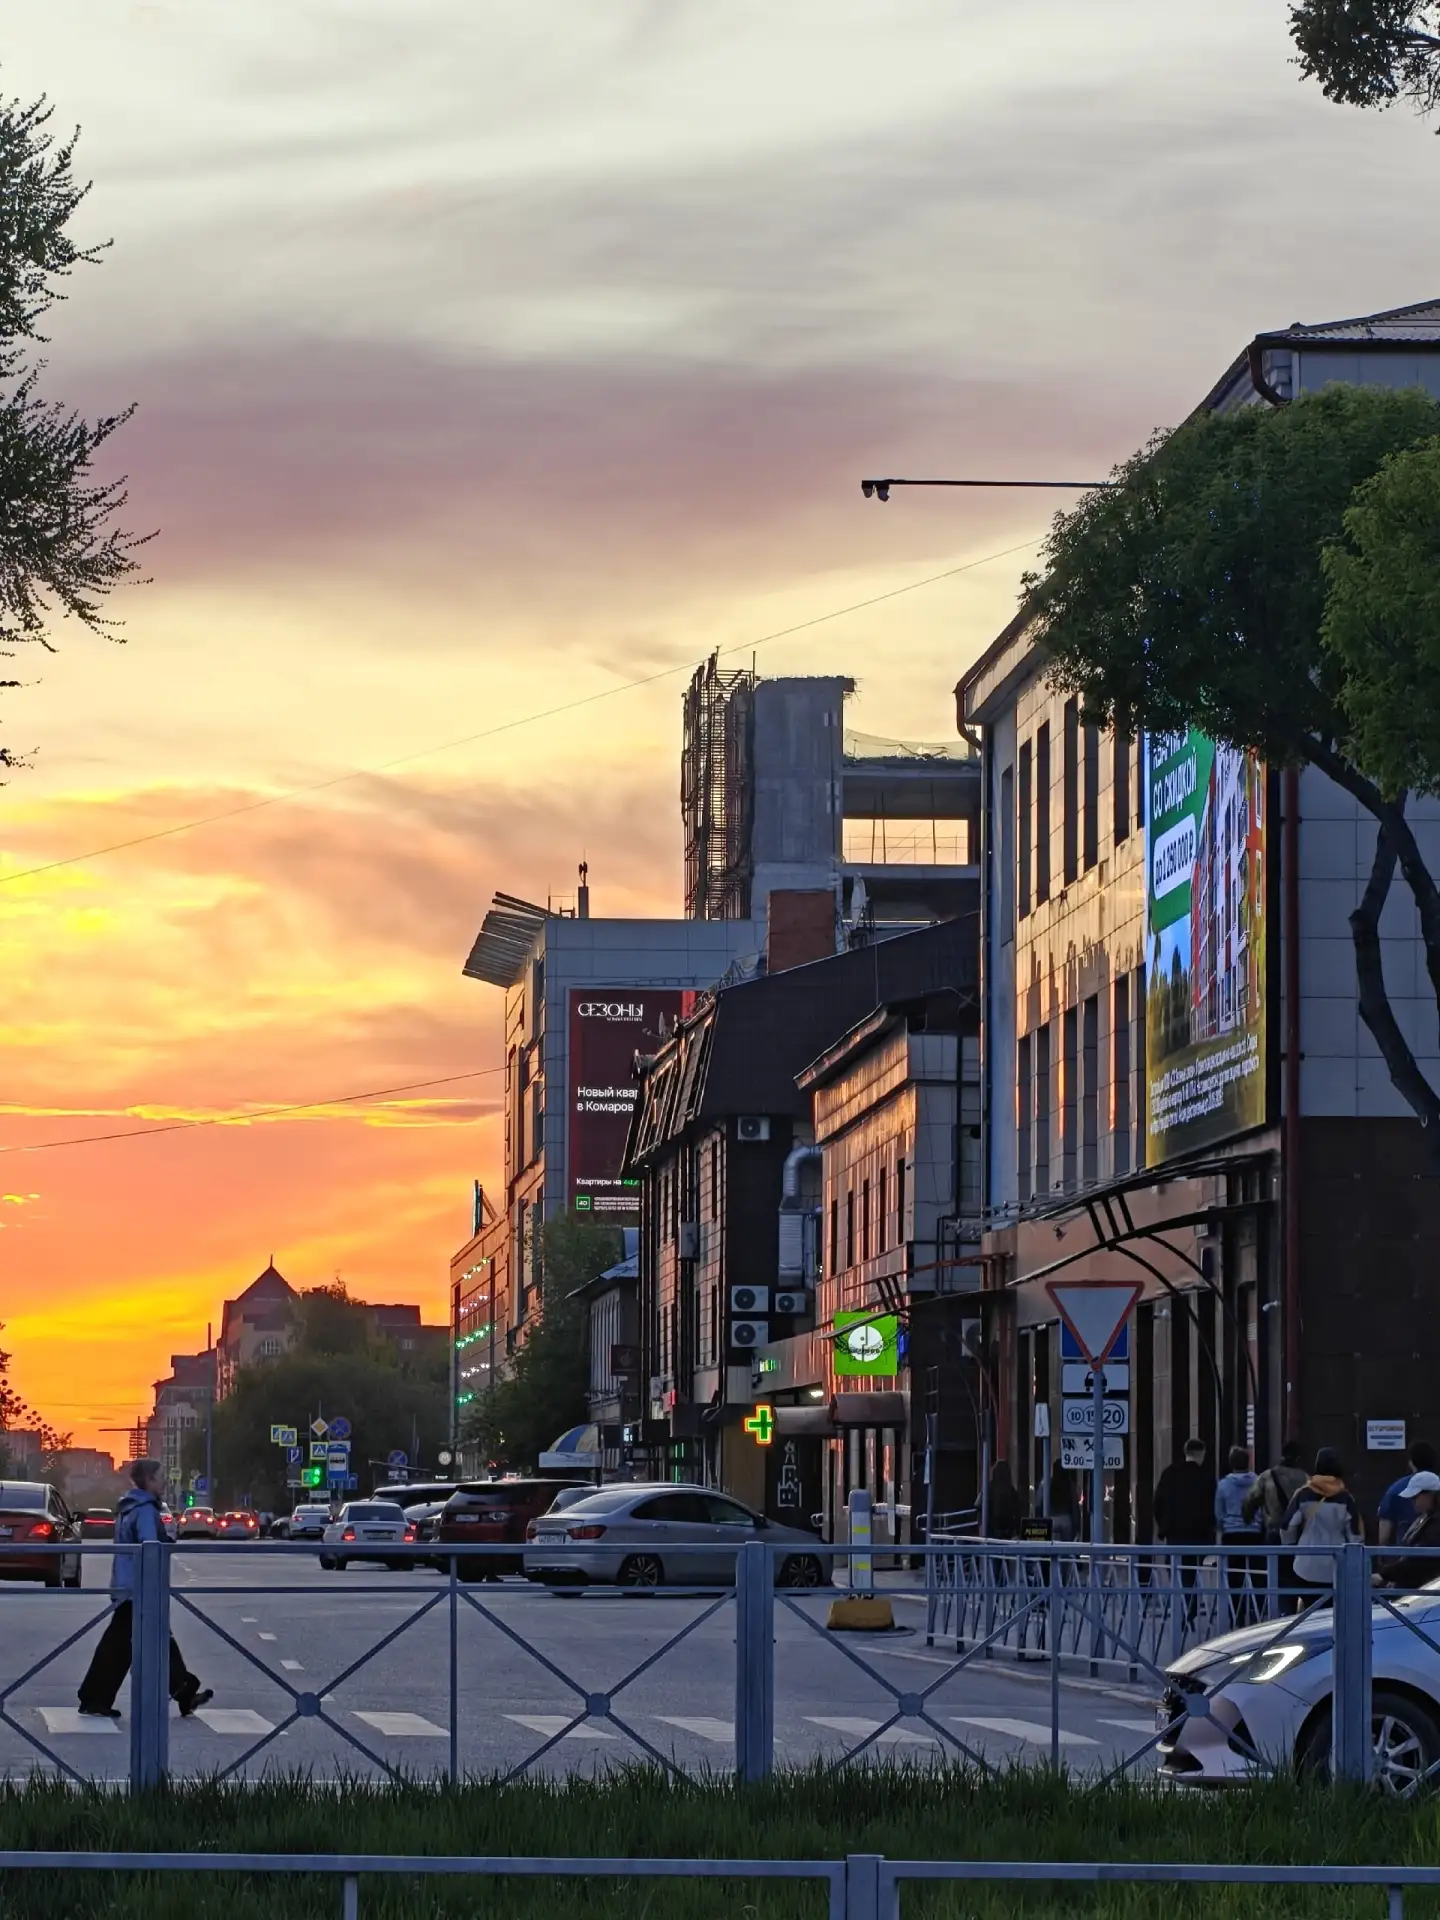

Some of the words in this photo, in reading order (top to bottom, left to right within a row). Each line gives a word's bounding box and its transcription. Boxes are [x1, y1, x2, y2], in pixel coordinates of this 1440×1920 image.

[1164, 745, 1197, 813] СКИДКОЙ
[577, 1002, 644, 1017] СЕЗОНЫ
[577, 1086, 614, 1098] Новый
[577, 1103, 584, 1111] в
[576, 1177, 612, 1187] Квартиры
[1070, 1411, 1081, 1421] 10
[1103, 1409, 1121, 1424] 20
[1064, 1453, 1084, 1466] 9.00
